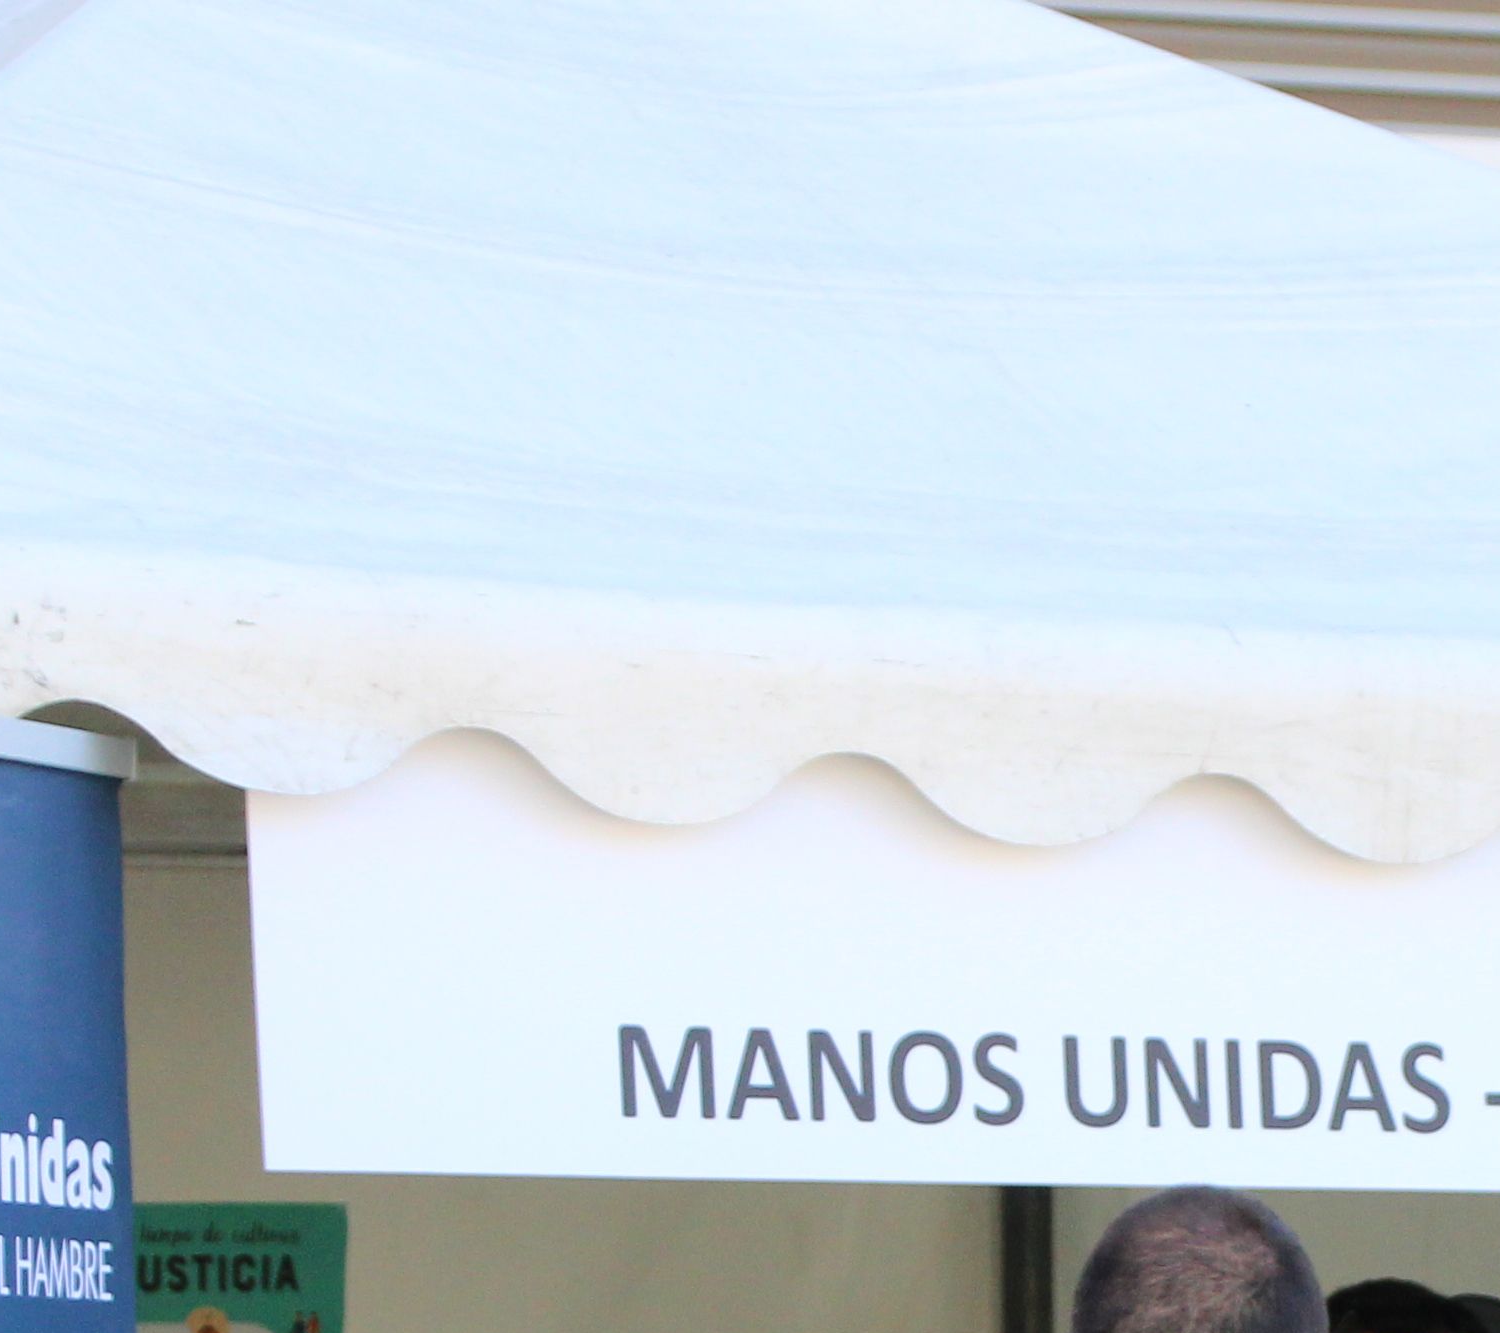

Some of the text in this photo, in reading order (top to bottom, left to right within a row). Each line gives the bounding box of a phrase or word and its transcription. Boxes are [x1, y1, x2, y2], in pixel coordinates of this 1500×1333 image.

[617, 1024, 1027, 1128] MANOS
[1063, 1034, 1451, 1135] UNIDAS
[15, 1236, 115, 1302] HAMBRE
[138, 1253, 300, 1293] USTICIA
